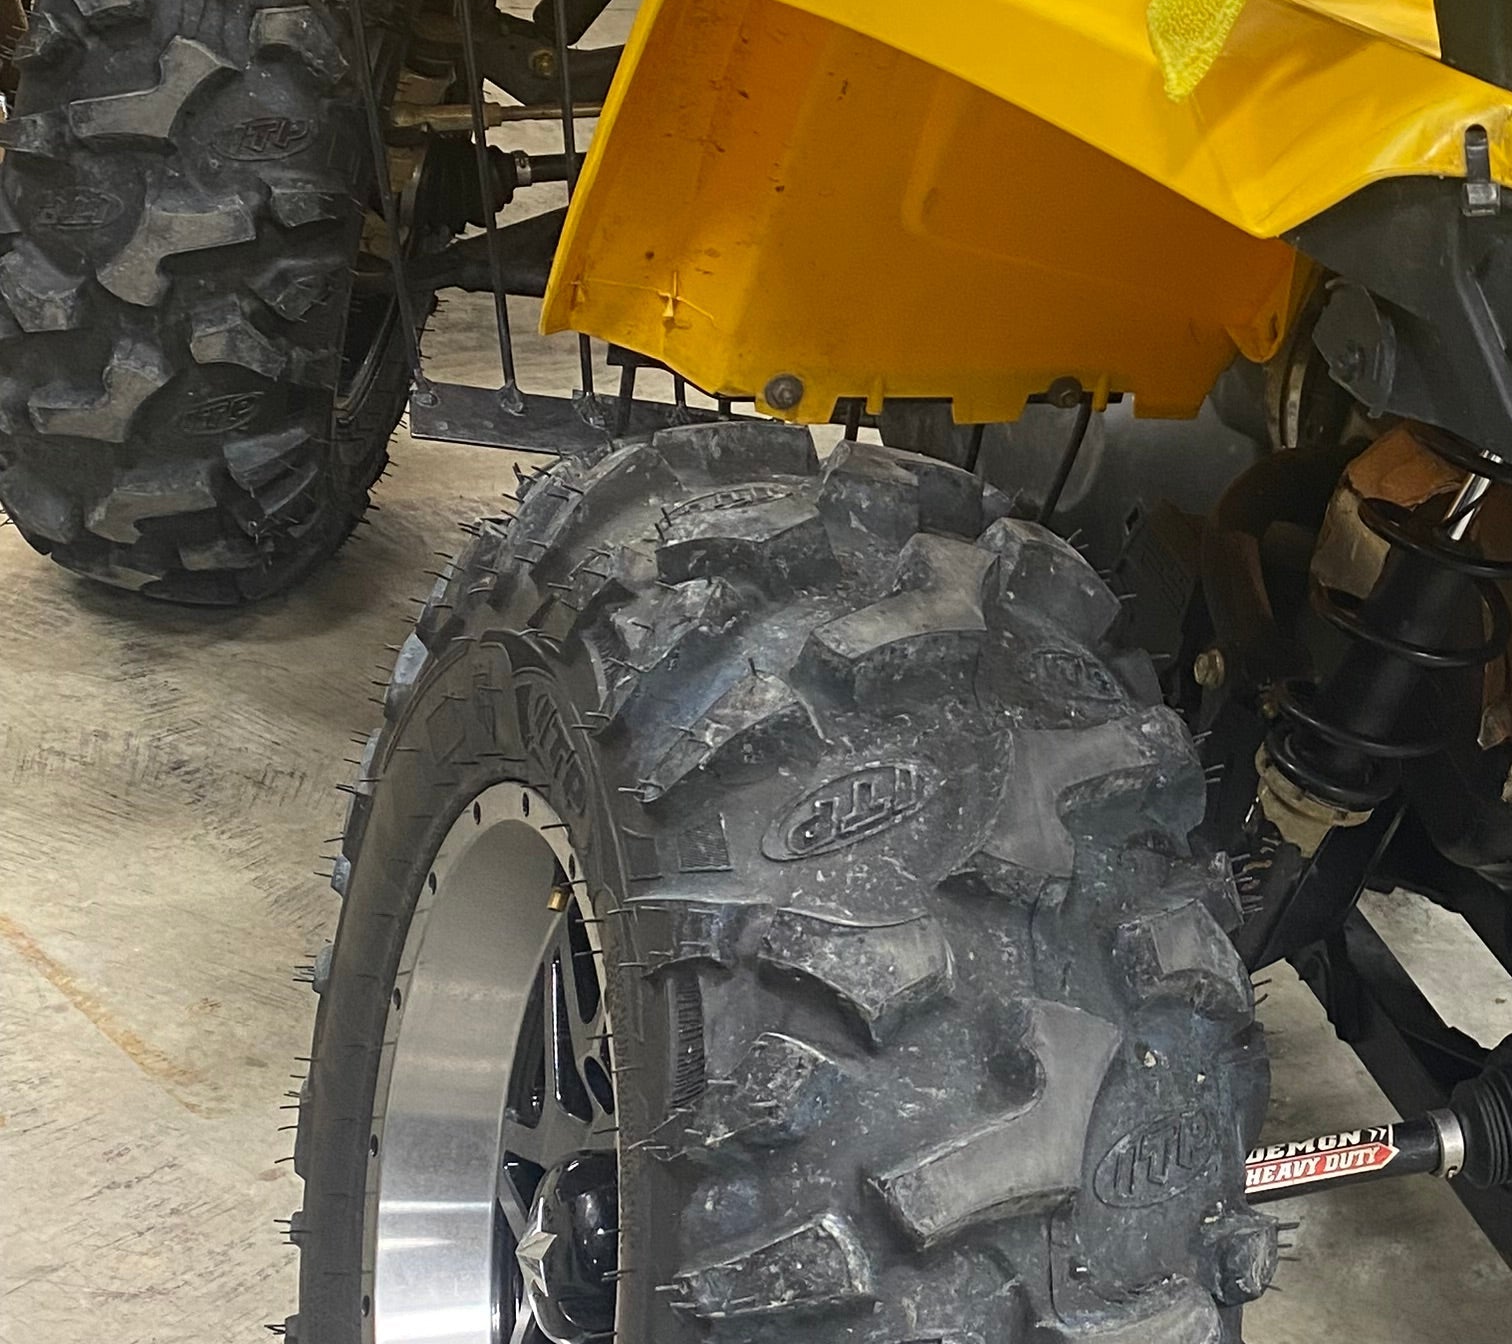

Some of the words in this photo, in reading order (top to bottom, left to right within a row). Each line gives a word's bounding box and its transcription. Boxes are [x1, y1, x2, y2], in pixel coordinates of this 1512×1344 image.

[787, 764, 920, 855] ITP
[1245, 1128, 1362, 1164] DEMON
[1246, 1156, 1321, 1187] HEAVY
[1322, 1146, 1381, 1173] DUTY
